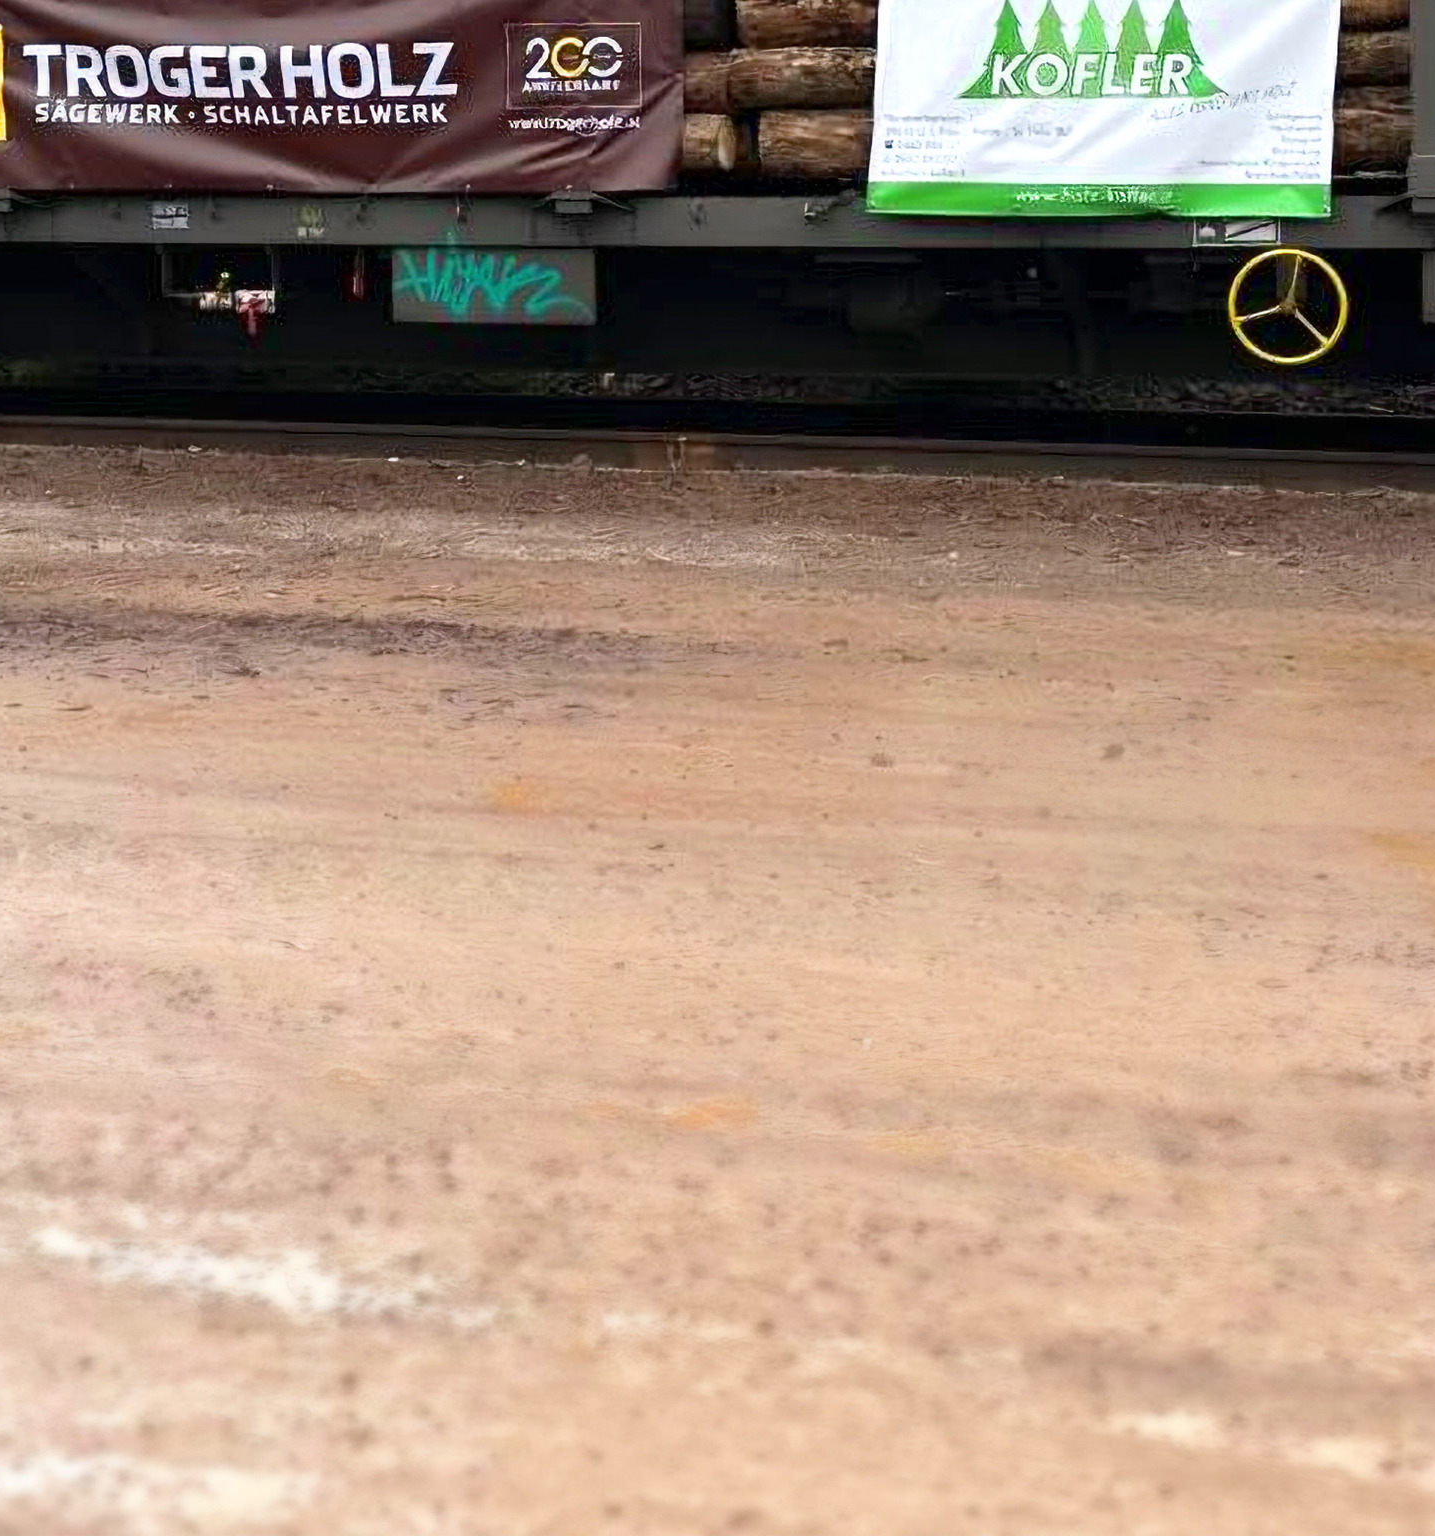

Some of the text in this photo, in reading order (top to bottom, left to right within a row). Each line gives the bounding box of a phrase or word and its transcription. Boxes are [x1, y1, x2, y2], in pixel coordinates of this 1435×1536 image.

[990, 51, 1193, 96] KOFLER
[34, 98, 449, 125] SÄGEWERK SCHALTAFELWERK
